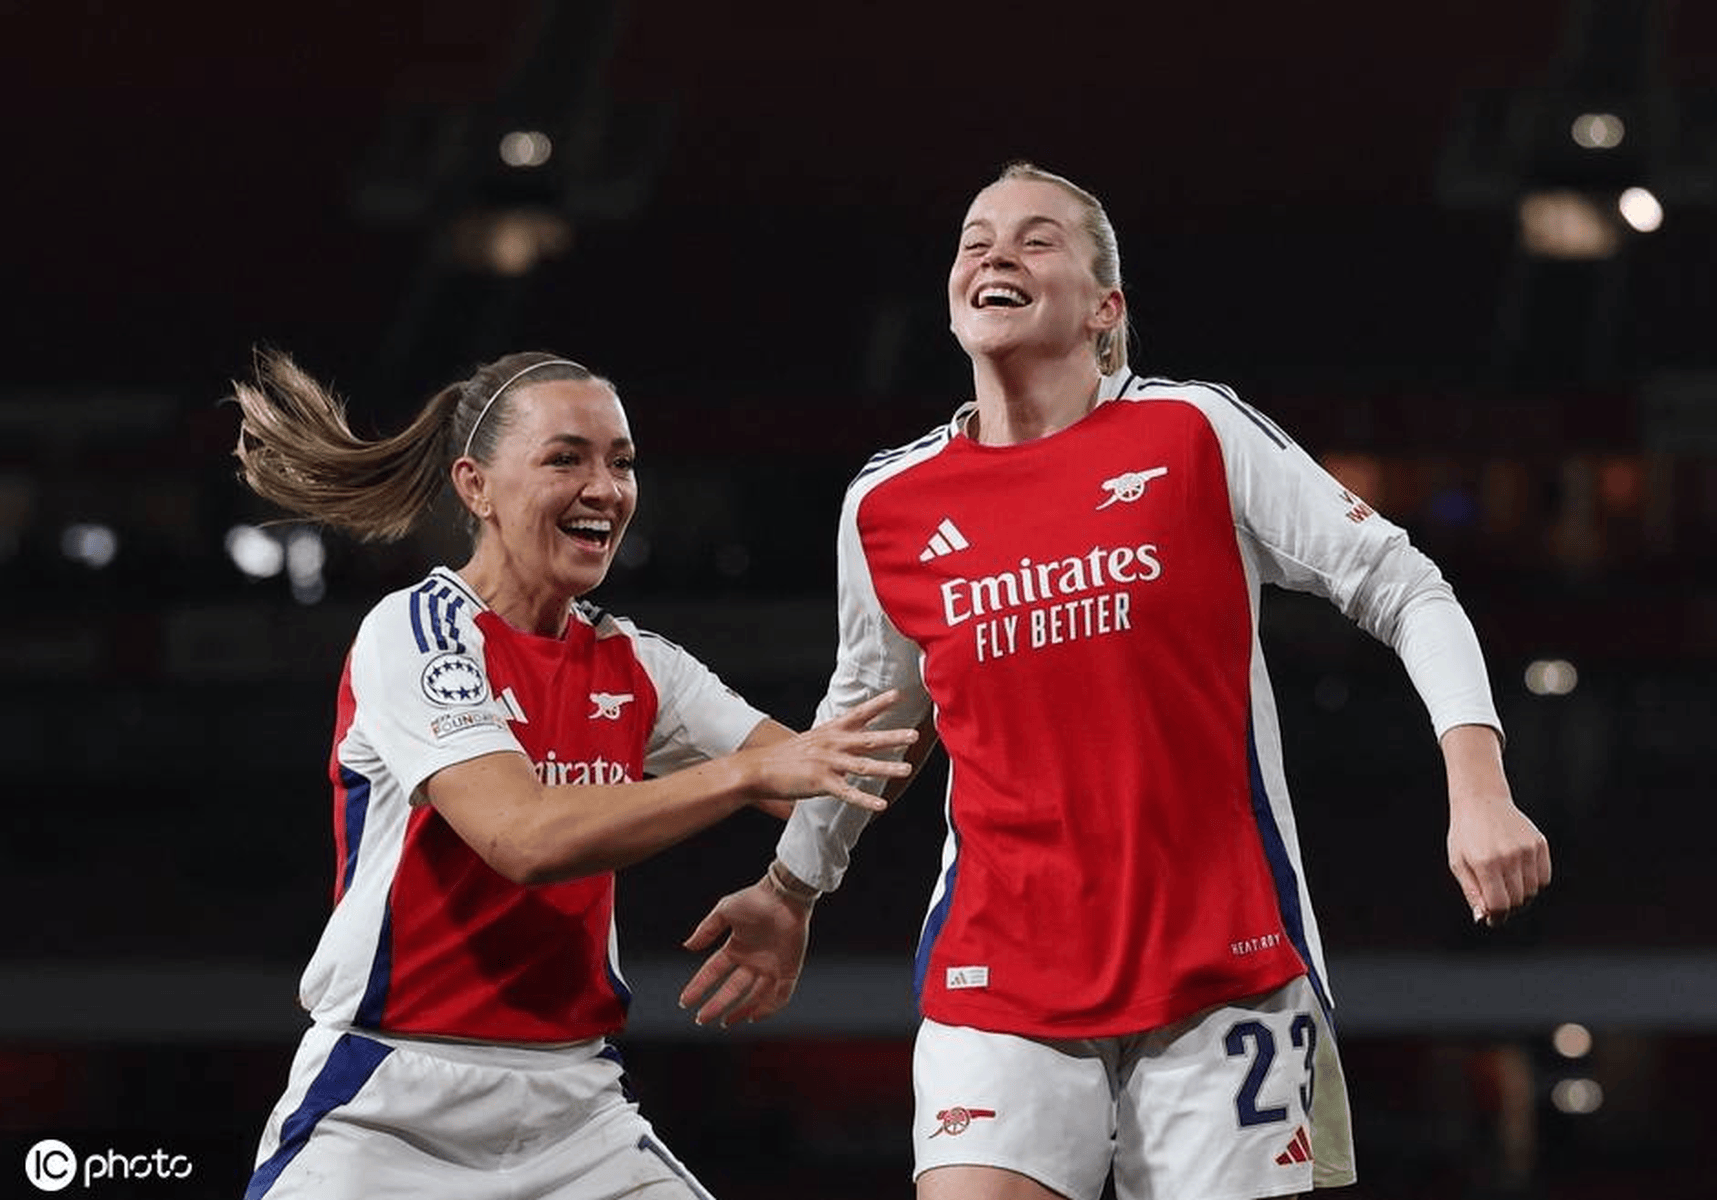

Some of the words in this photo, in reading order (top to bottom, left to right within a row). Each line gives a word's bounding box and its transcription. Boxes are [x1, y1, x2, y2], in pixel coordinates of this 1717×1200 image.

[941, 545, 1161, 626] Emirates
[976, 615, 1018, 662] FLY
[1031, 593, 1131, 648] BETTER
[1224, 1013, 1316, 1127] 23
